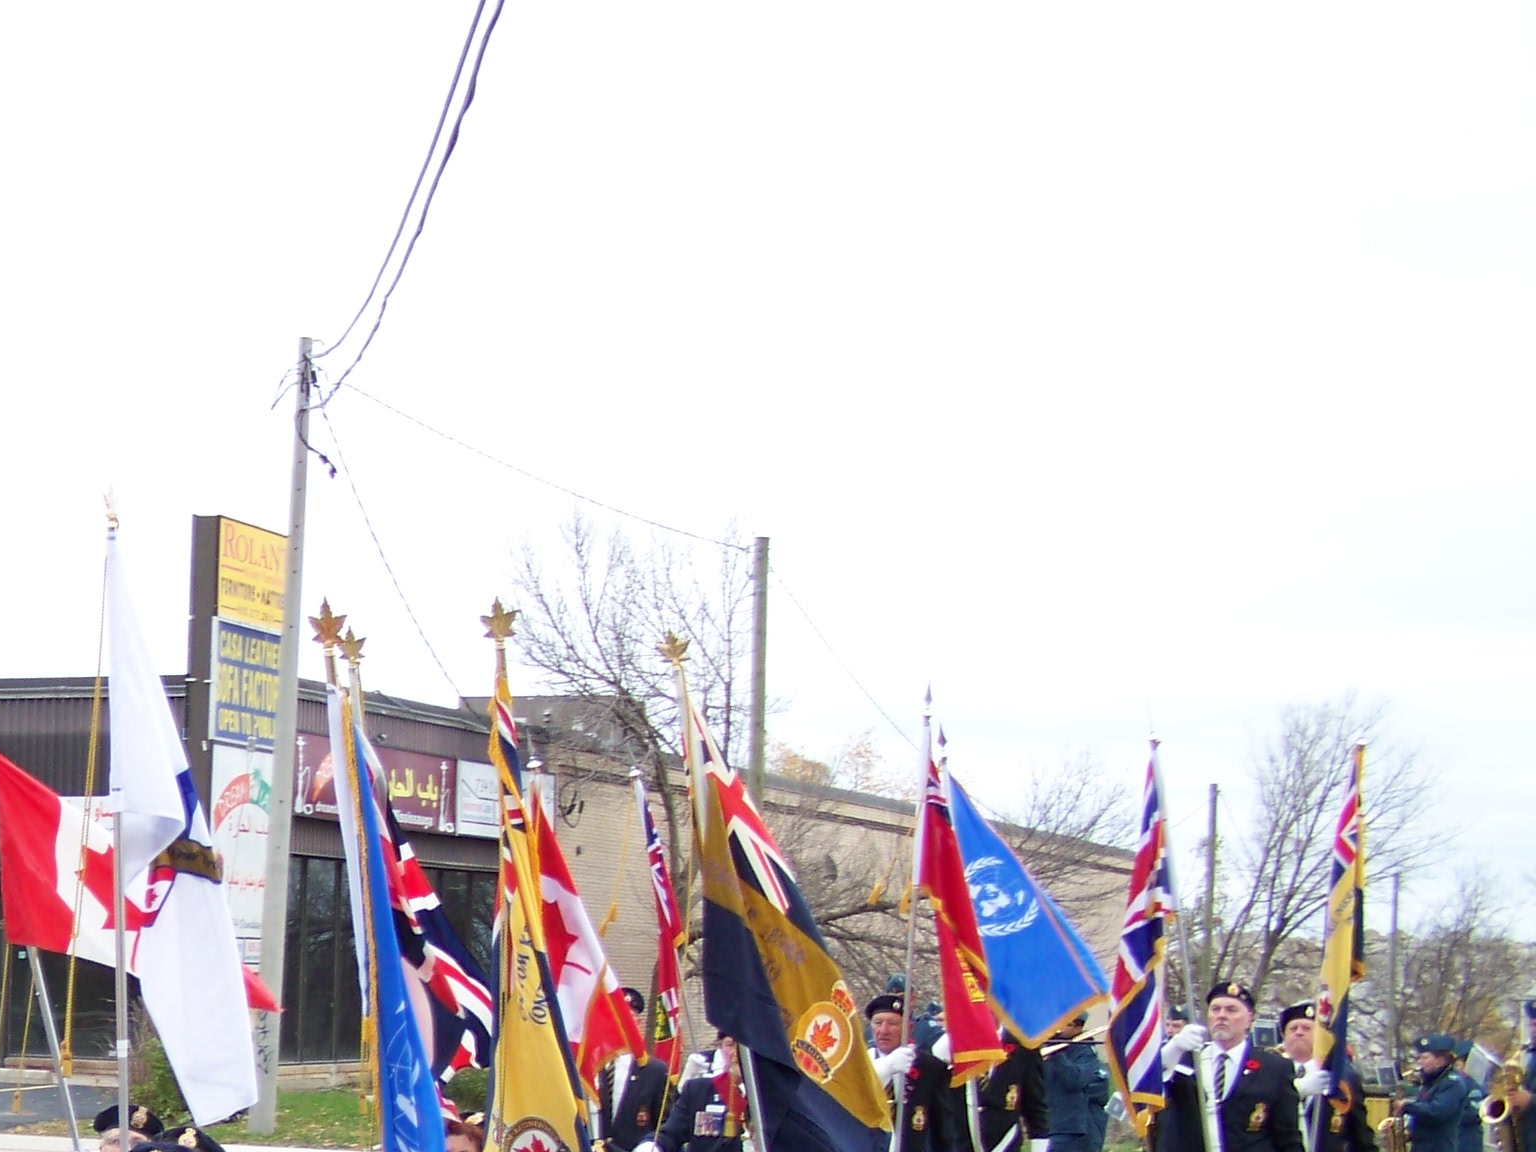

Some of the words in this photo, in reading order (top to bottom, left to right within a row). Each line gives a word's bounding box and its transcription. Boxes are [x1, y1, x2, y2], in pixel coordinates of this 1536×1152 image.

[223, 522, 286, 573] ROLAN
[219, 630, 243, 661] CASA
[244, 636, 281, 669] LEATHE
